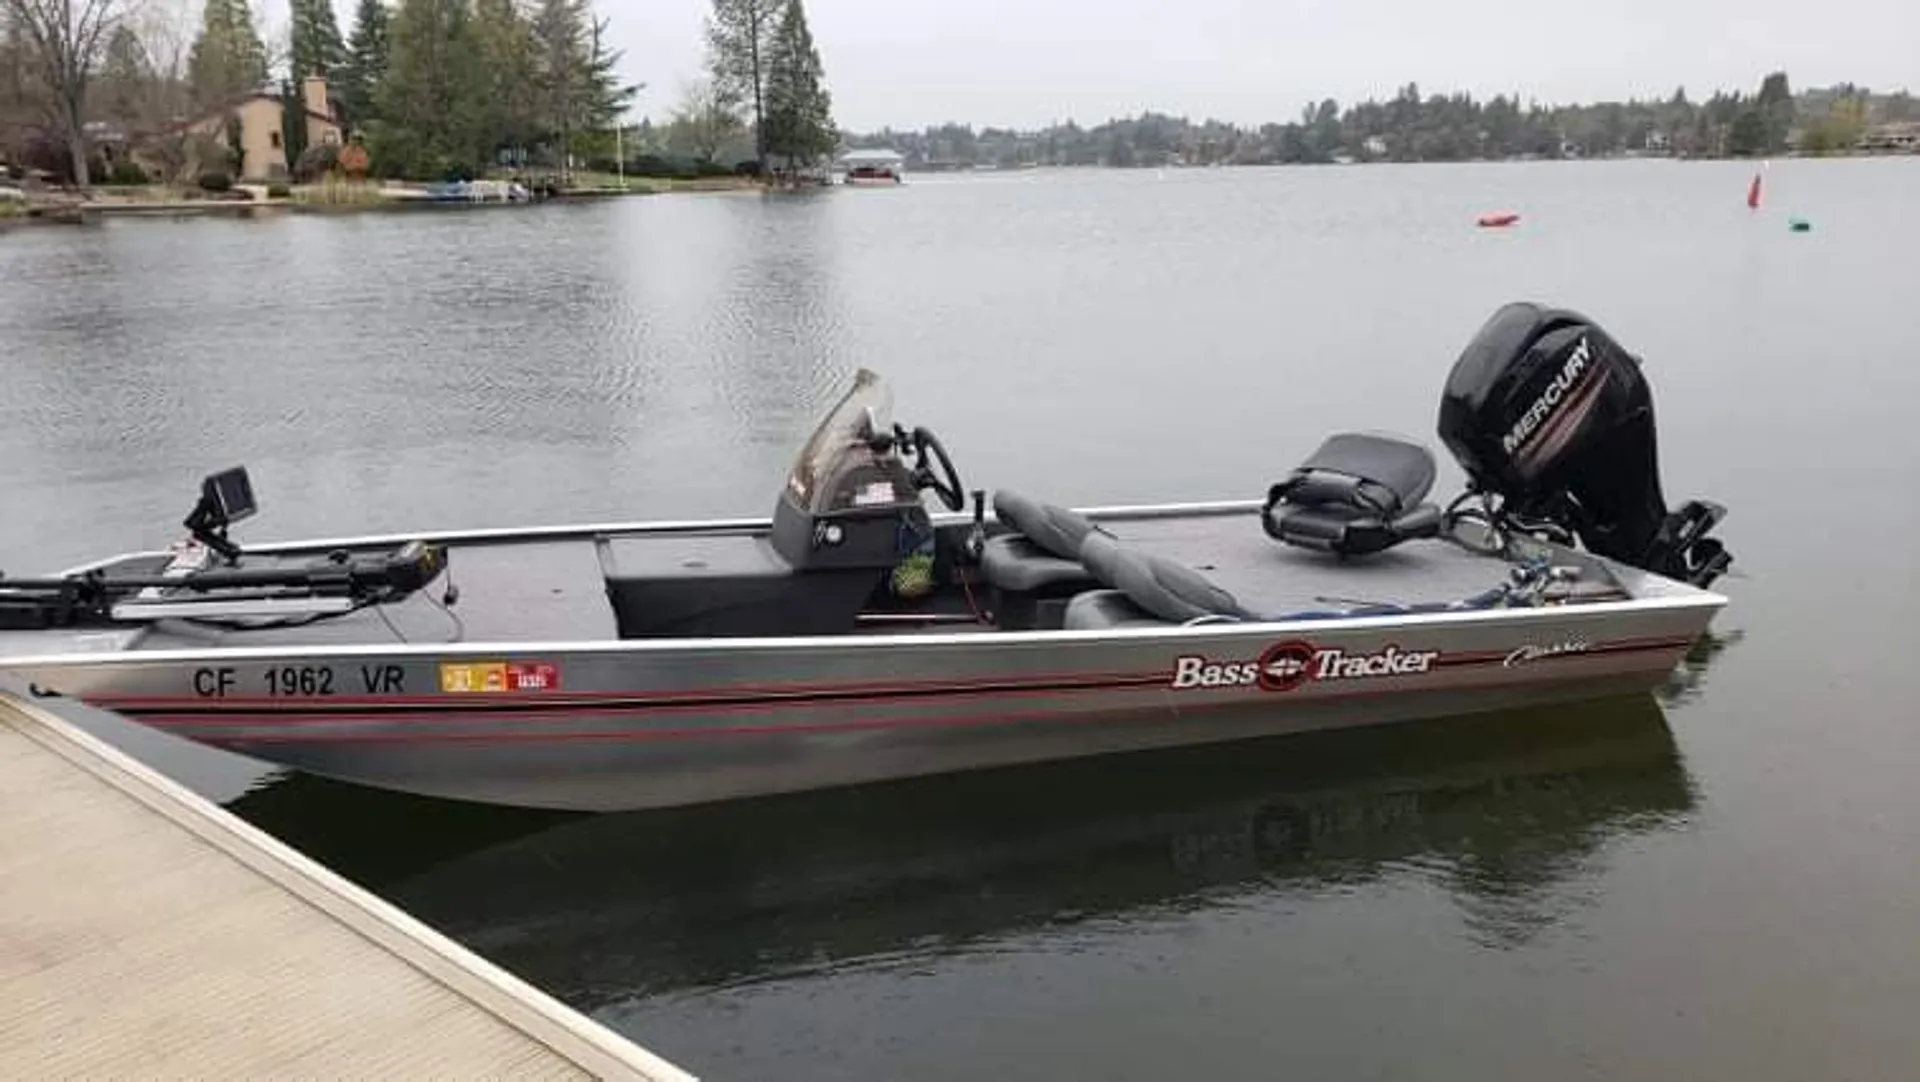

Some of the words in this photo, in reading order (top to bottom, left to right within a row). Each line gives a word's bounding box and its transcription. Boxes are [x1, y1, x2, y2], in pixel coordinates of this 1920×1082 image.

[1503, 336, 1591, 453] MERCURY
[194, 668, 236, 697] CF
[264, 667, 334, 695] 1962
[361, 664, 406, 693] VR
[1173, 656, 1258, 688] Bass
[1314, 647, 1438, 679] Tracker
